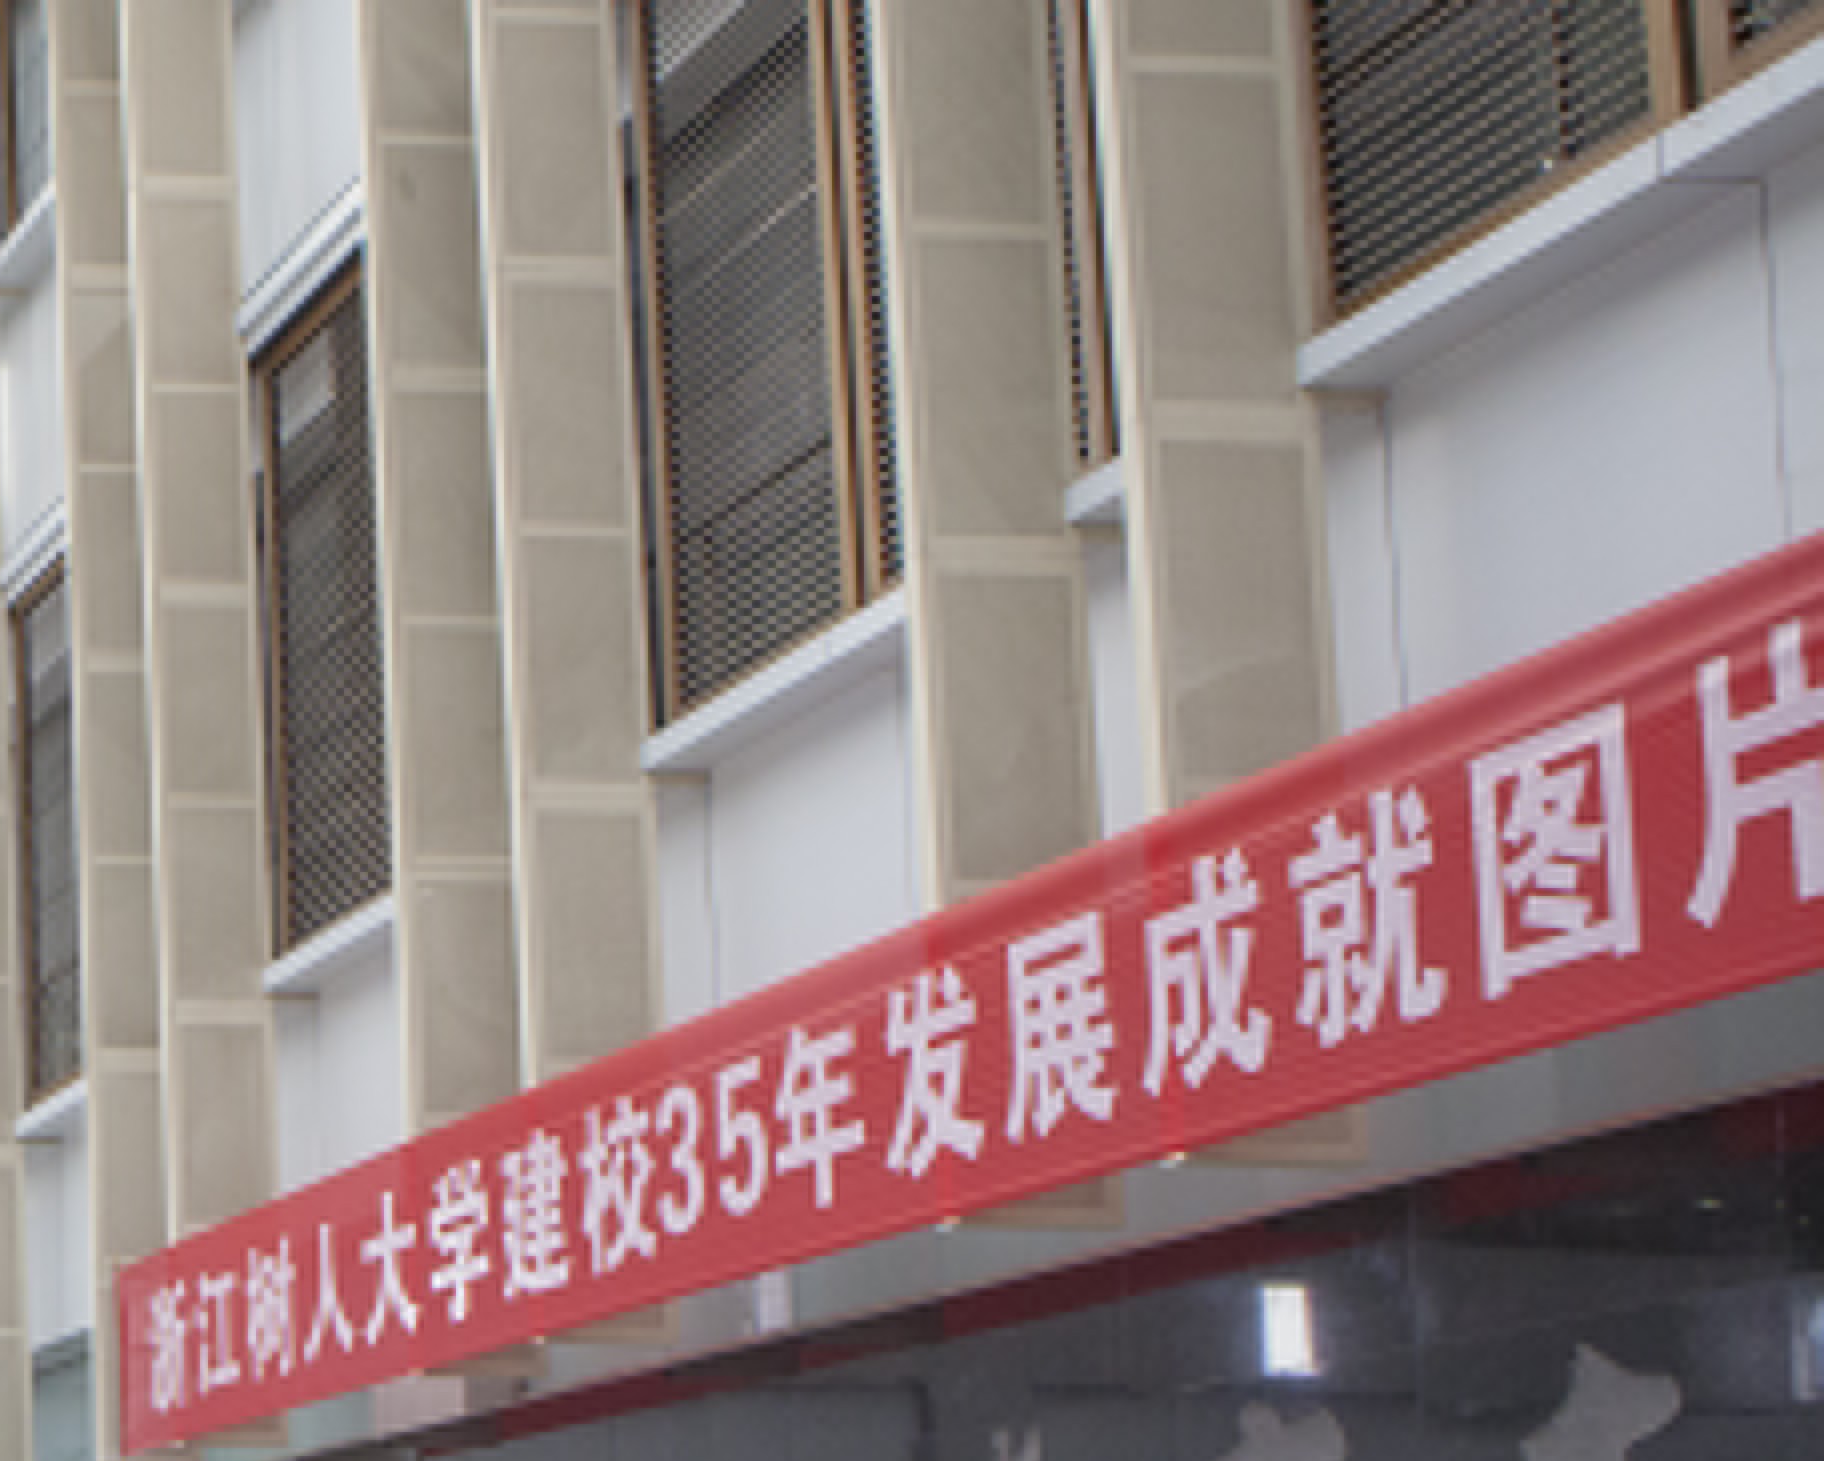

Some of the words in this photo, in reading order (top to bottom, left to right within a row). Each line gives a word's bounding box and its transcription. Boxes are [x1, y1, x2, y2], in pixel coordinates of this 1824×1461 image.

[147, 616, 1824, 1414] 浙江树人大学建校35年发展成就图片
